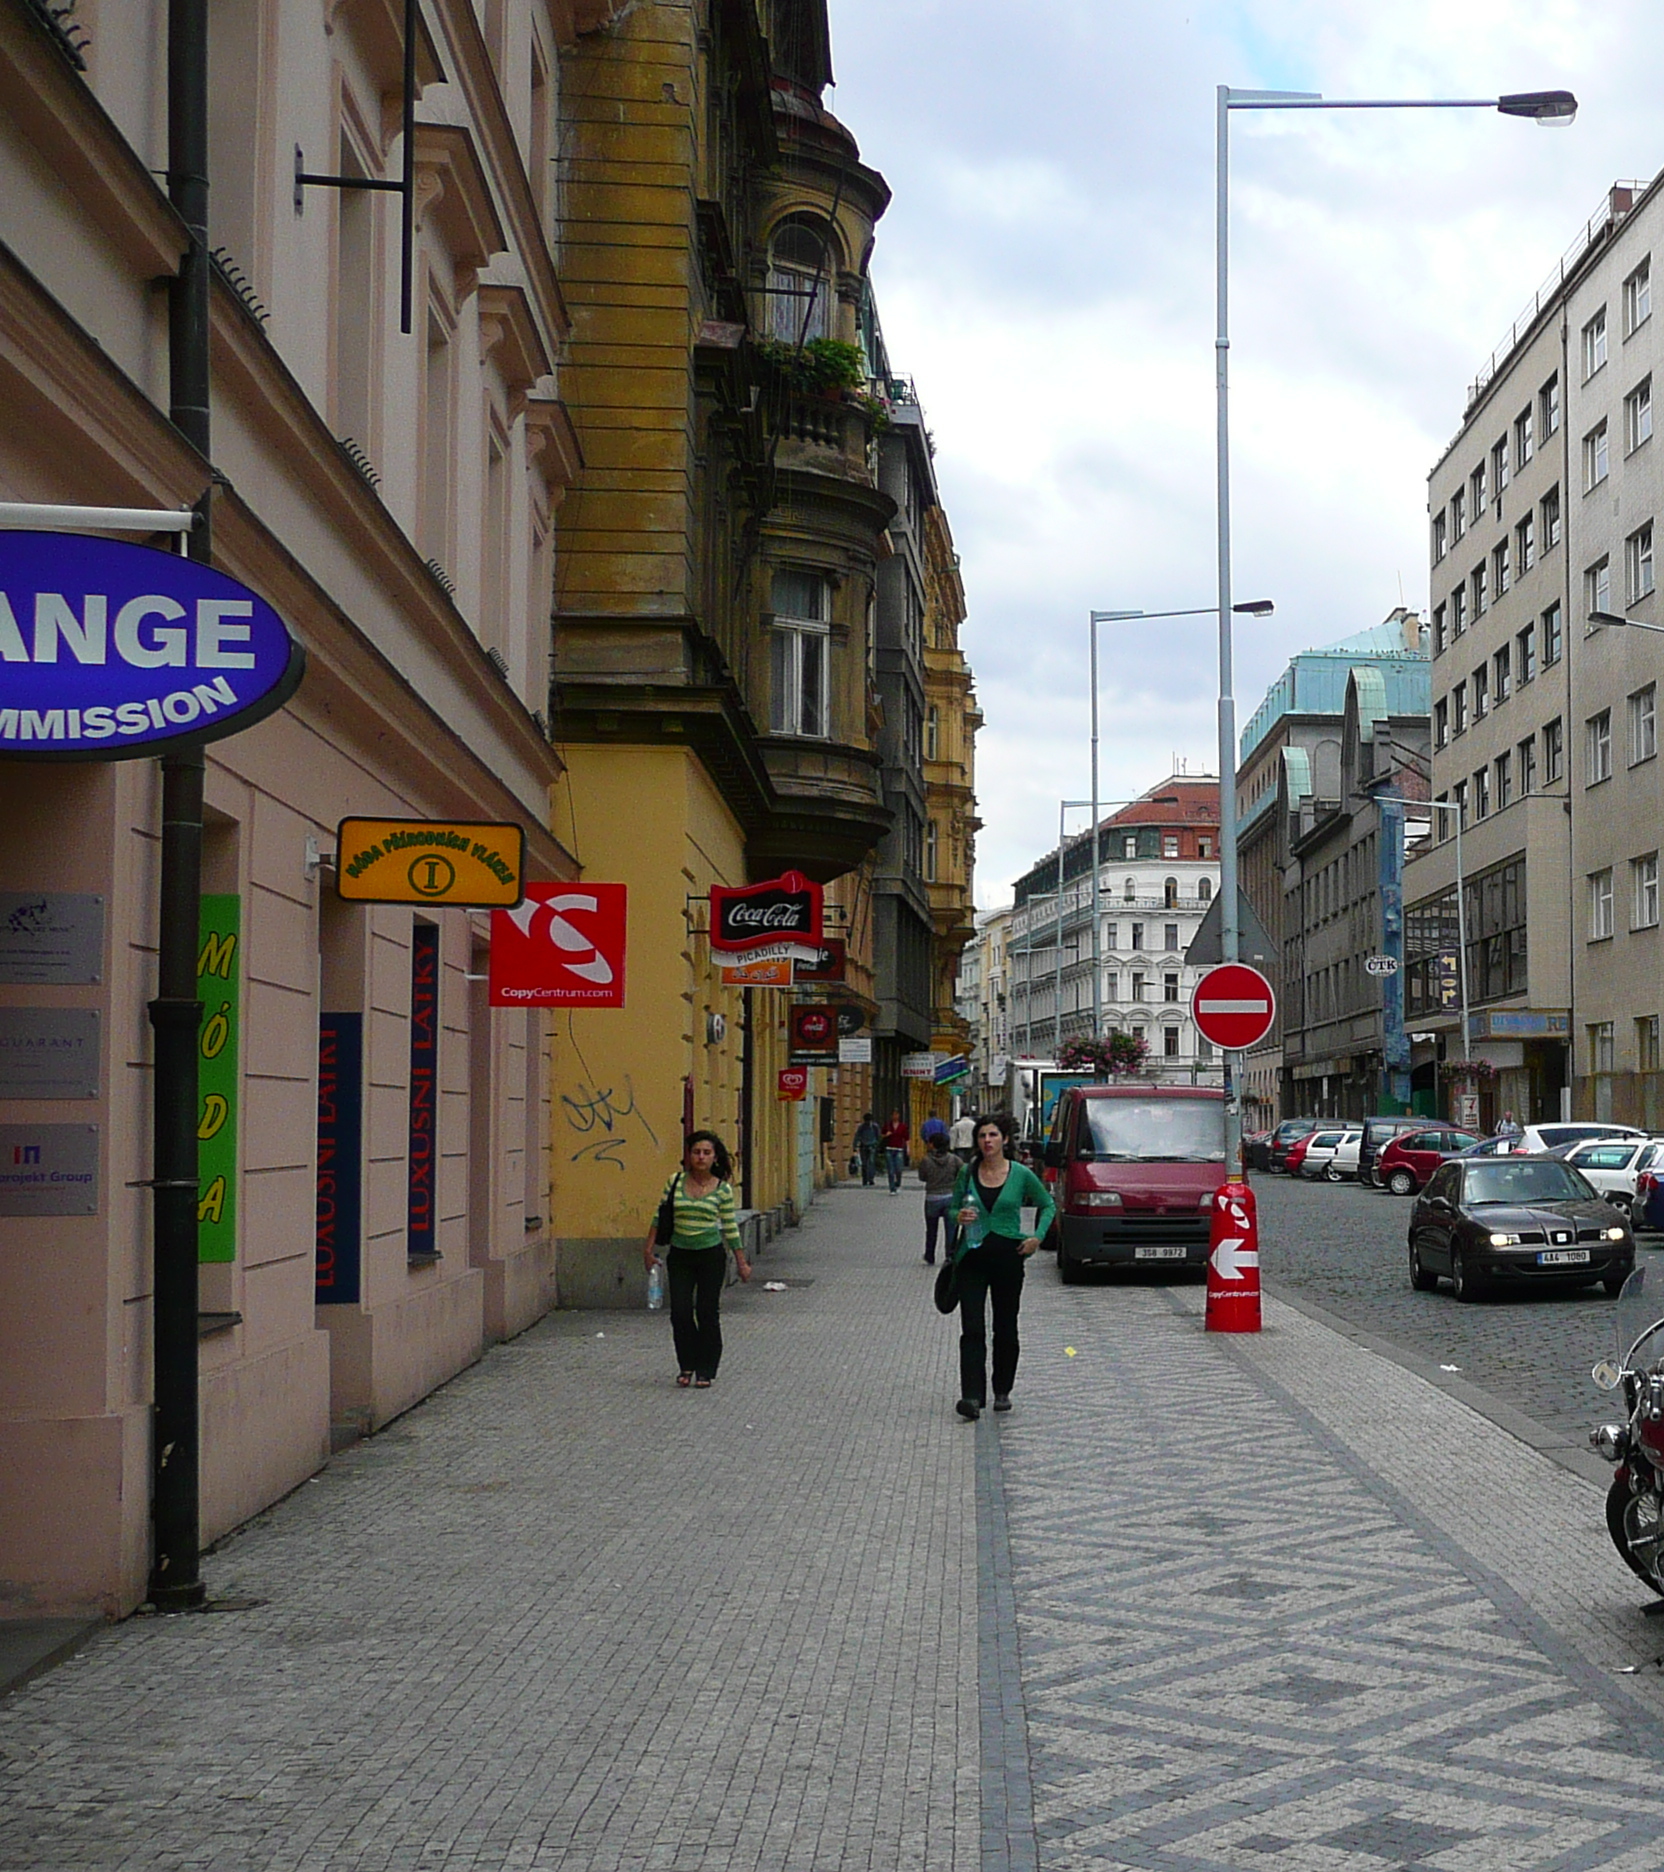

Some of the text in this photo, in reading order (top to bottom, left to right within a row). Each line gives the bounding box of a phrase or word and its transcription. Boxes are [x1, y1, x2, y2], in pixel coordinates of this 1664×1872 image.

[736, 945, 791, 964] PICADILLY
[501, 987, 613, 999] CopyCentrum.com
[50, 1171, 93, 1184] Group
